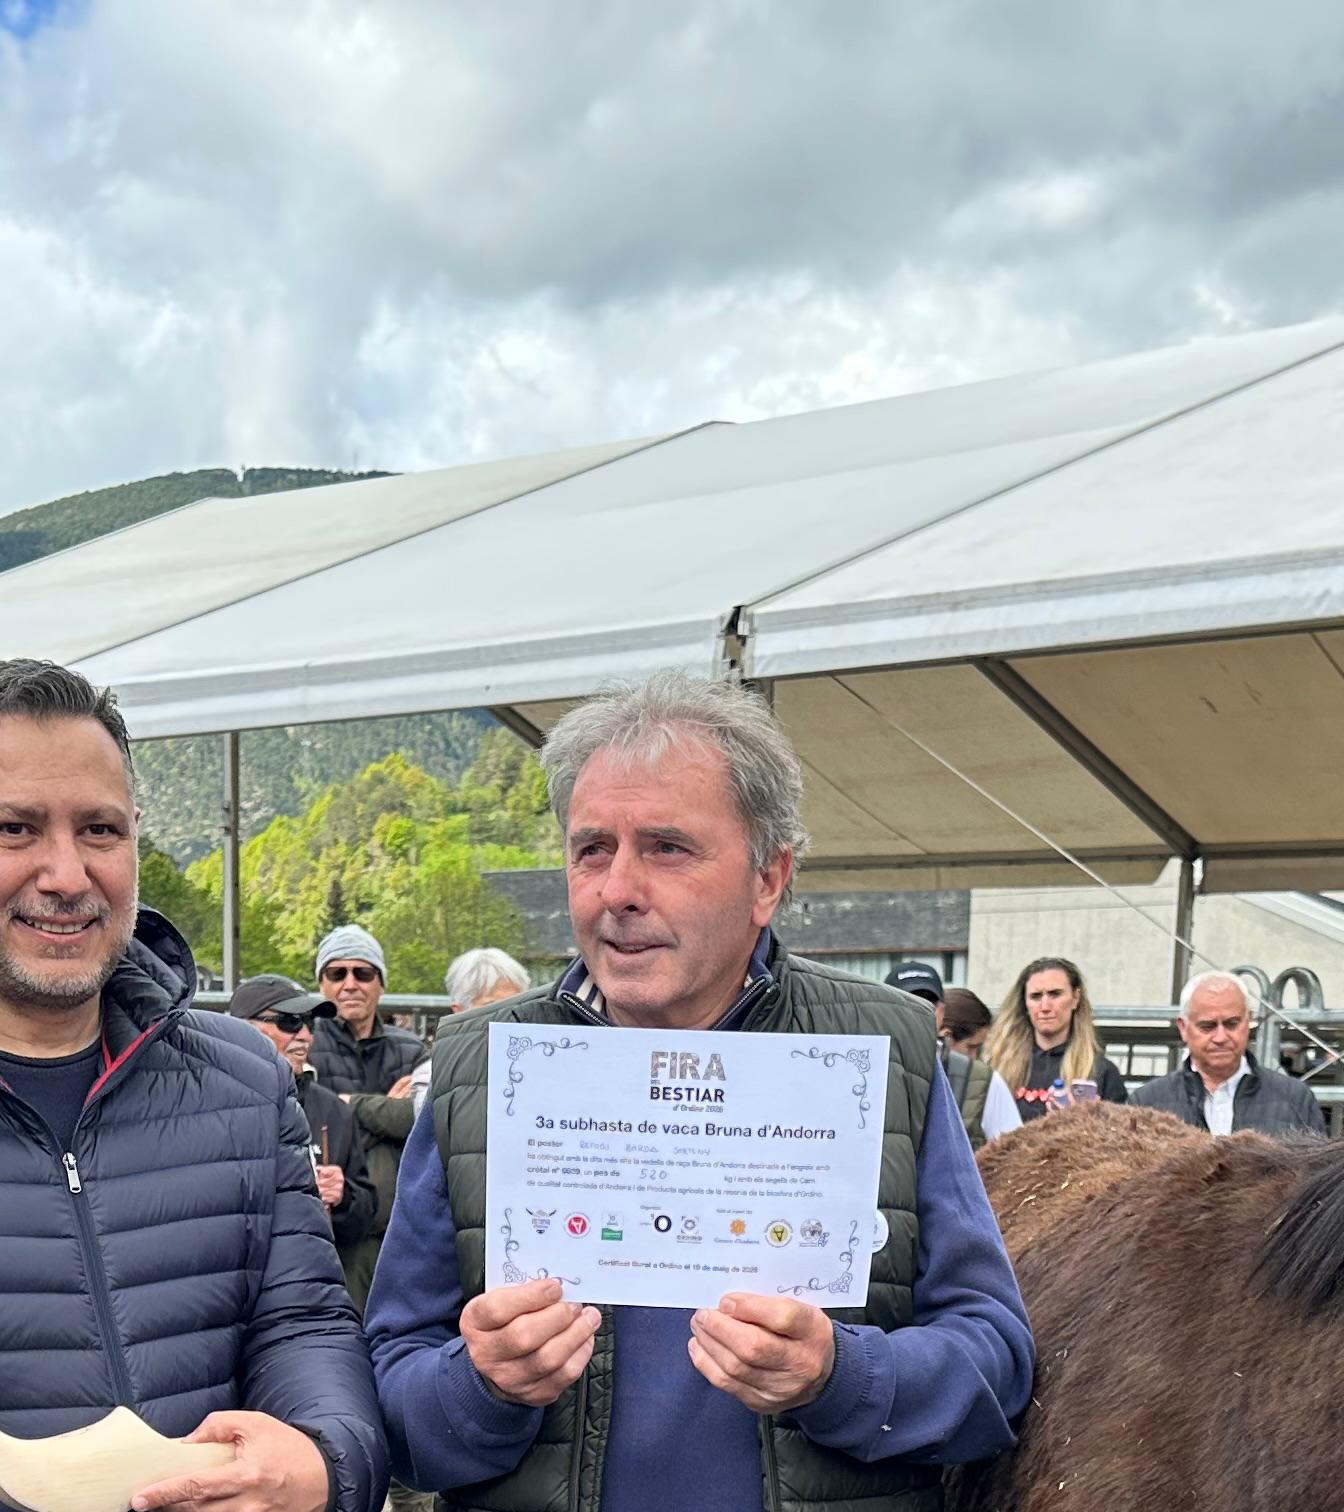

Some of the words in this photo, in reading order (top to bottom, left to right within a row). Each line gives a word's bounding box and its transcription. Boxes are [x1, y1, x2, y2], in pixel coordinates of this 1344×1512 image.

[650, 1051, 725, 1080] FIRA
[650, 1086, 724, 1102] BESTIAR
[535, 1115, 554, 1128] 3a
[559, 1117, 632, 1132] subhasta
[637, 1120, 657, 1133] de
[662, 1124, 699, 1135] vaca
[705, 1122, 751, 1137] Bruna
[757, 1124, 835, 1139] d'Andorra
[527, 1138, 535, 1146] El
[639, 1168, 667, 1180] 520
